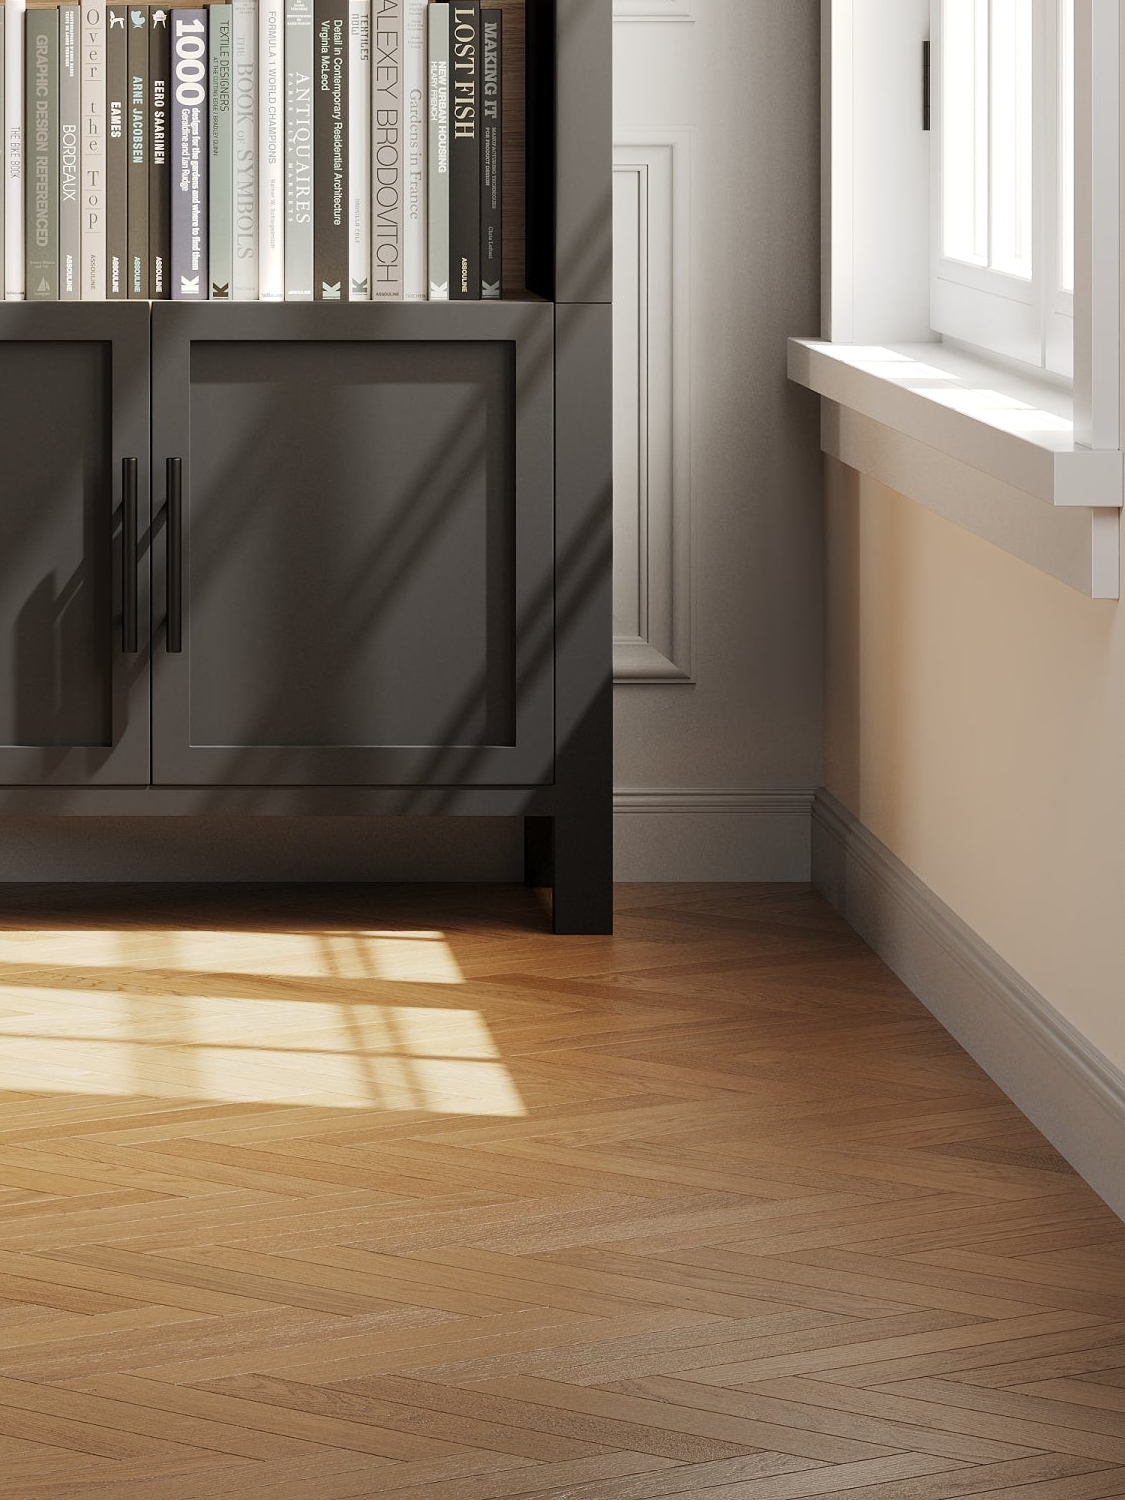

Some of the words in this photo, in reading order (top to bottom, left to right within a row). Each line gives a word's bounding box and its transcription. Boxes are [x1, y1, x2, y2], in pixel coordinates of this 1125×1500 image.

[219, 20, 229, 57] TEXTILE
[320, 20, 330, 53] Virginia
[333, 19, 343, 47] Detail
[360, 13, 369, 61] TEXTILES
[454, 7, 475, 75] LOST
[36, 34, 48, 97] GRAPHIC
[176, 18, 206, 106] 1000
[321, 55, 330, 91] McLeod
[430, 61, 438, 87] HILARY
[438, 61, 447, 85] NEW
[484, 22, 497, 95] MAKING
[132, 76, 143, 105] ARNE
[154, 80, 165, 107] EERO
[219, 60, 229, 112] DESIGNERS
[331, 57, 343, 120] Contemporary
[111, 101, 121, 138] EAMES
[190, 107, 201, 135] designs
[430, 89, 438, 121] FRENCH
[438, 87, 447, 123] URBAN
[454, 80, 475, 139] FISH
[484, 100, 497, 119] IT
[10, 126, 21, 139] THE
[36, 100, 48, 150] DESIGN
[132, 108, 143, 163] JACOBSEN
[154, 110, 165, 164] SAARINEN
[181, 108, 190, 141] Geraldine
[191, 135, 201, 147] for
[10, 141, 21, 157] BIKE
[63, 124, 76, 201] BORDEAUX
[181, 142, 190, 154] and
[181, 156, 190, 168] Ian
[191, 148, 201, 159] the
[293, 71, 310, 223] ANTIQUAIRES
[333, 122, 343, 171] Residential
[438, 125, 447, 173] HOUSING
[10, 161, 21, 179] BOOK
[180, 169, 190, 191] Rudge
[190, 160, 201, 189] gardens
[36, 155, 48, 246] REFERENCED
[191, 190, 201, 203] and
[333, 173, 343, 225] Architecture
[376, 109, 398, 282] BRODOVITCH
[191, 204, 201, 226] where
[191, 227, 201, 235] to
[191, 236, 201, 250] find
[191, 251, 201, 270] them
